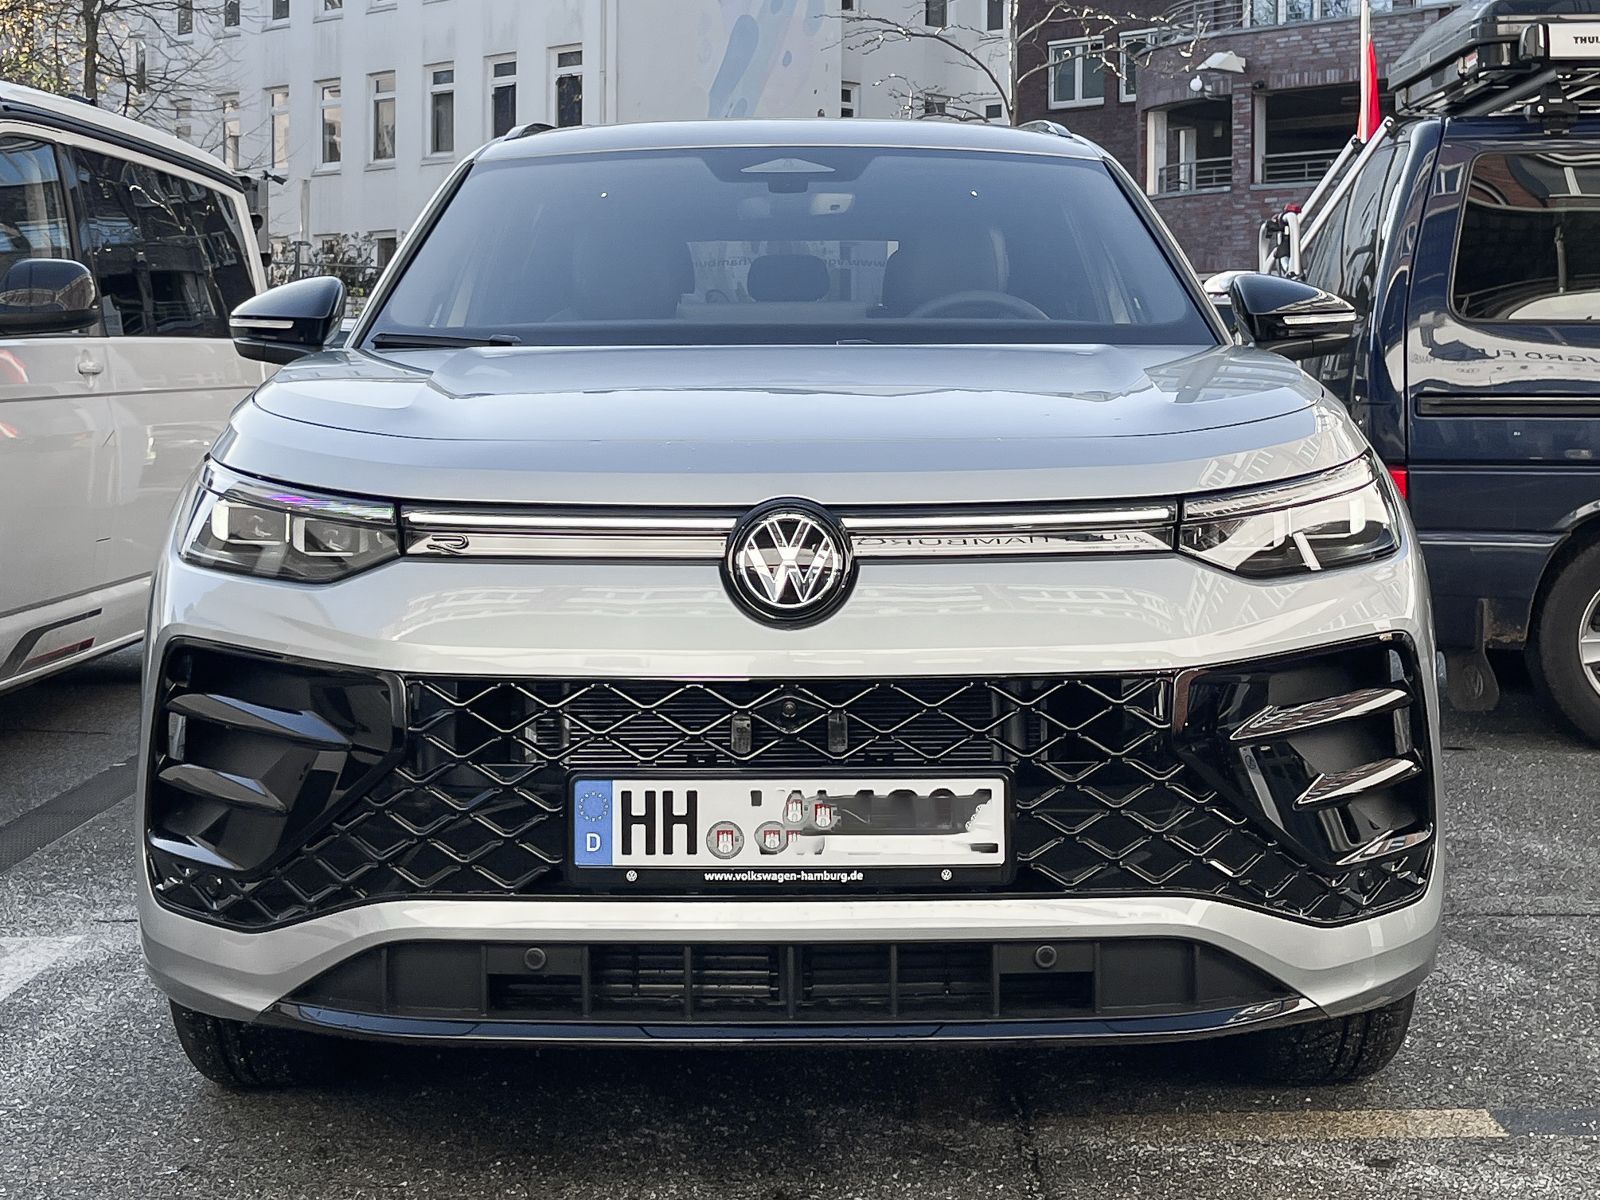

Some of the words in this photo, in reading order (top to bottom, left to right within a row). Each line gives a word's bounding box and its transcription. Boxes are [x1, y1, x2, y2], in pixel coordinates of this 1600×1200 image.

[586, 833, 602, 852] D
[621, 790, 698, 855] HH
[704, 871, 864, 883] www.volkswagen-hamburg.de
